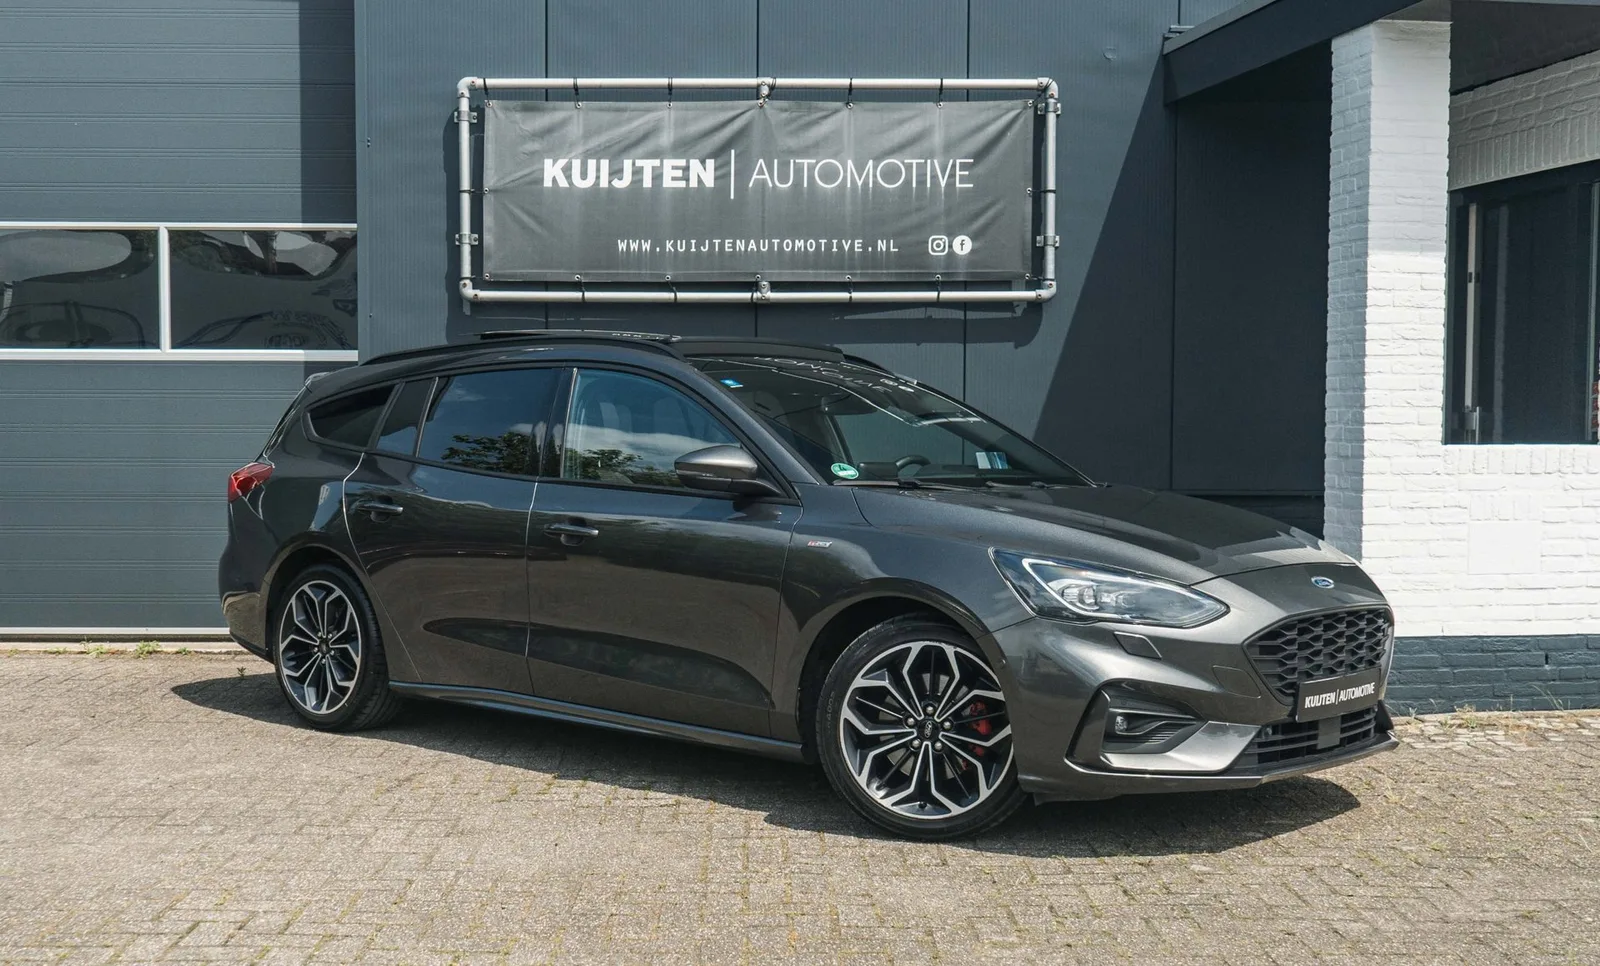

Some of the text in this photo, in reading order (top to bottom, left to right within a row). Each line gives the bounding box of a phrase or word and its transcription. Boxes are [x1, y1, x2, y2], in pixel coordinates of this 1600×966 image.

[543, 158, 974, 189] KUIJTEN AUTOMOTIVE
[617, 238, 899, 254] WWW.KUIJTENAUTOMOTIVE.NL
[1339, 682, 1375, 702] AUTOMOTIVE
